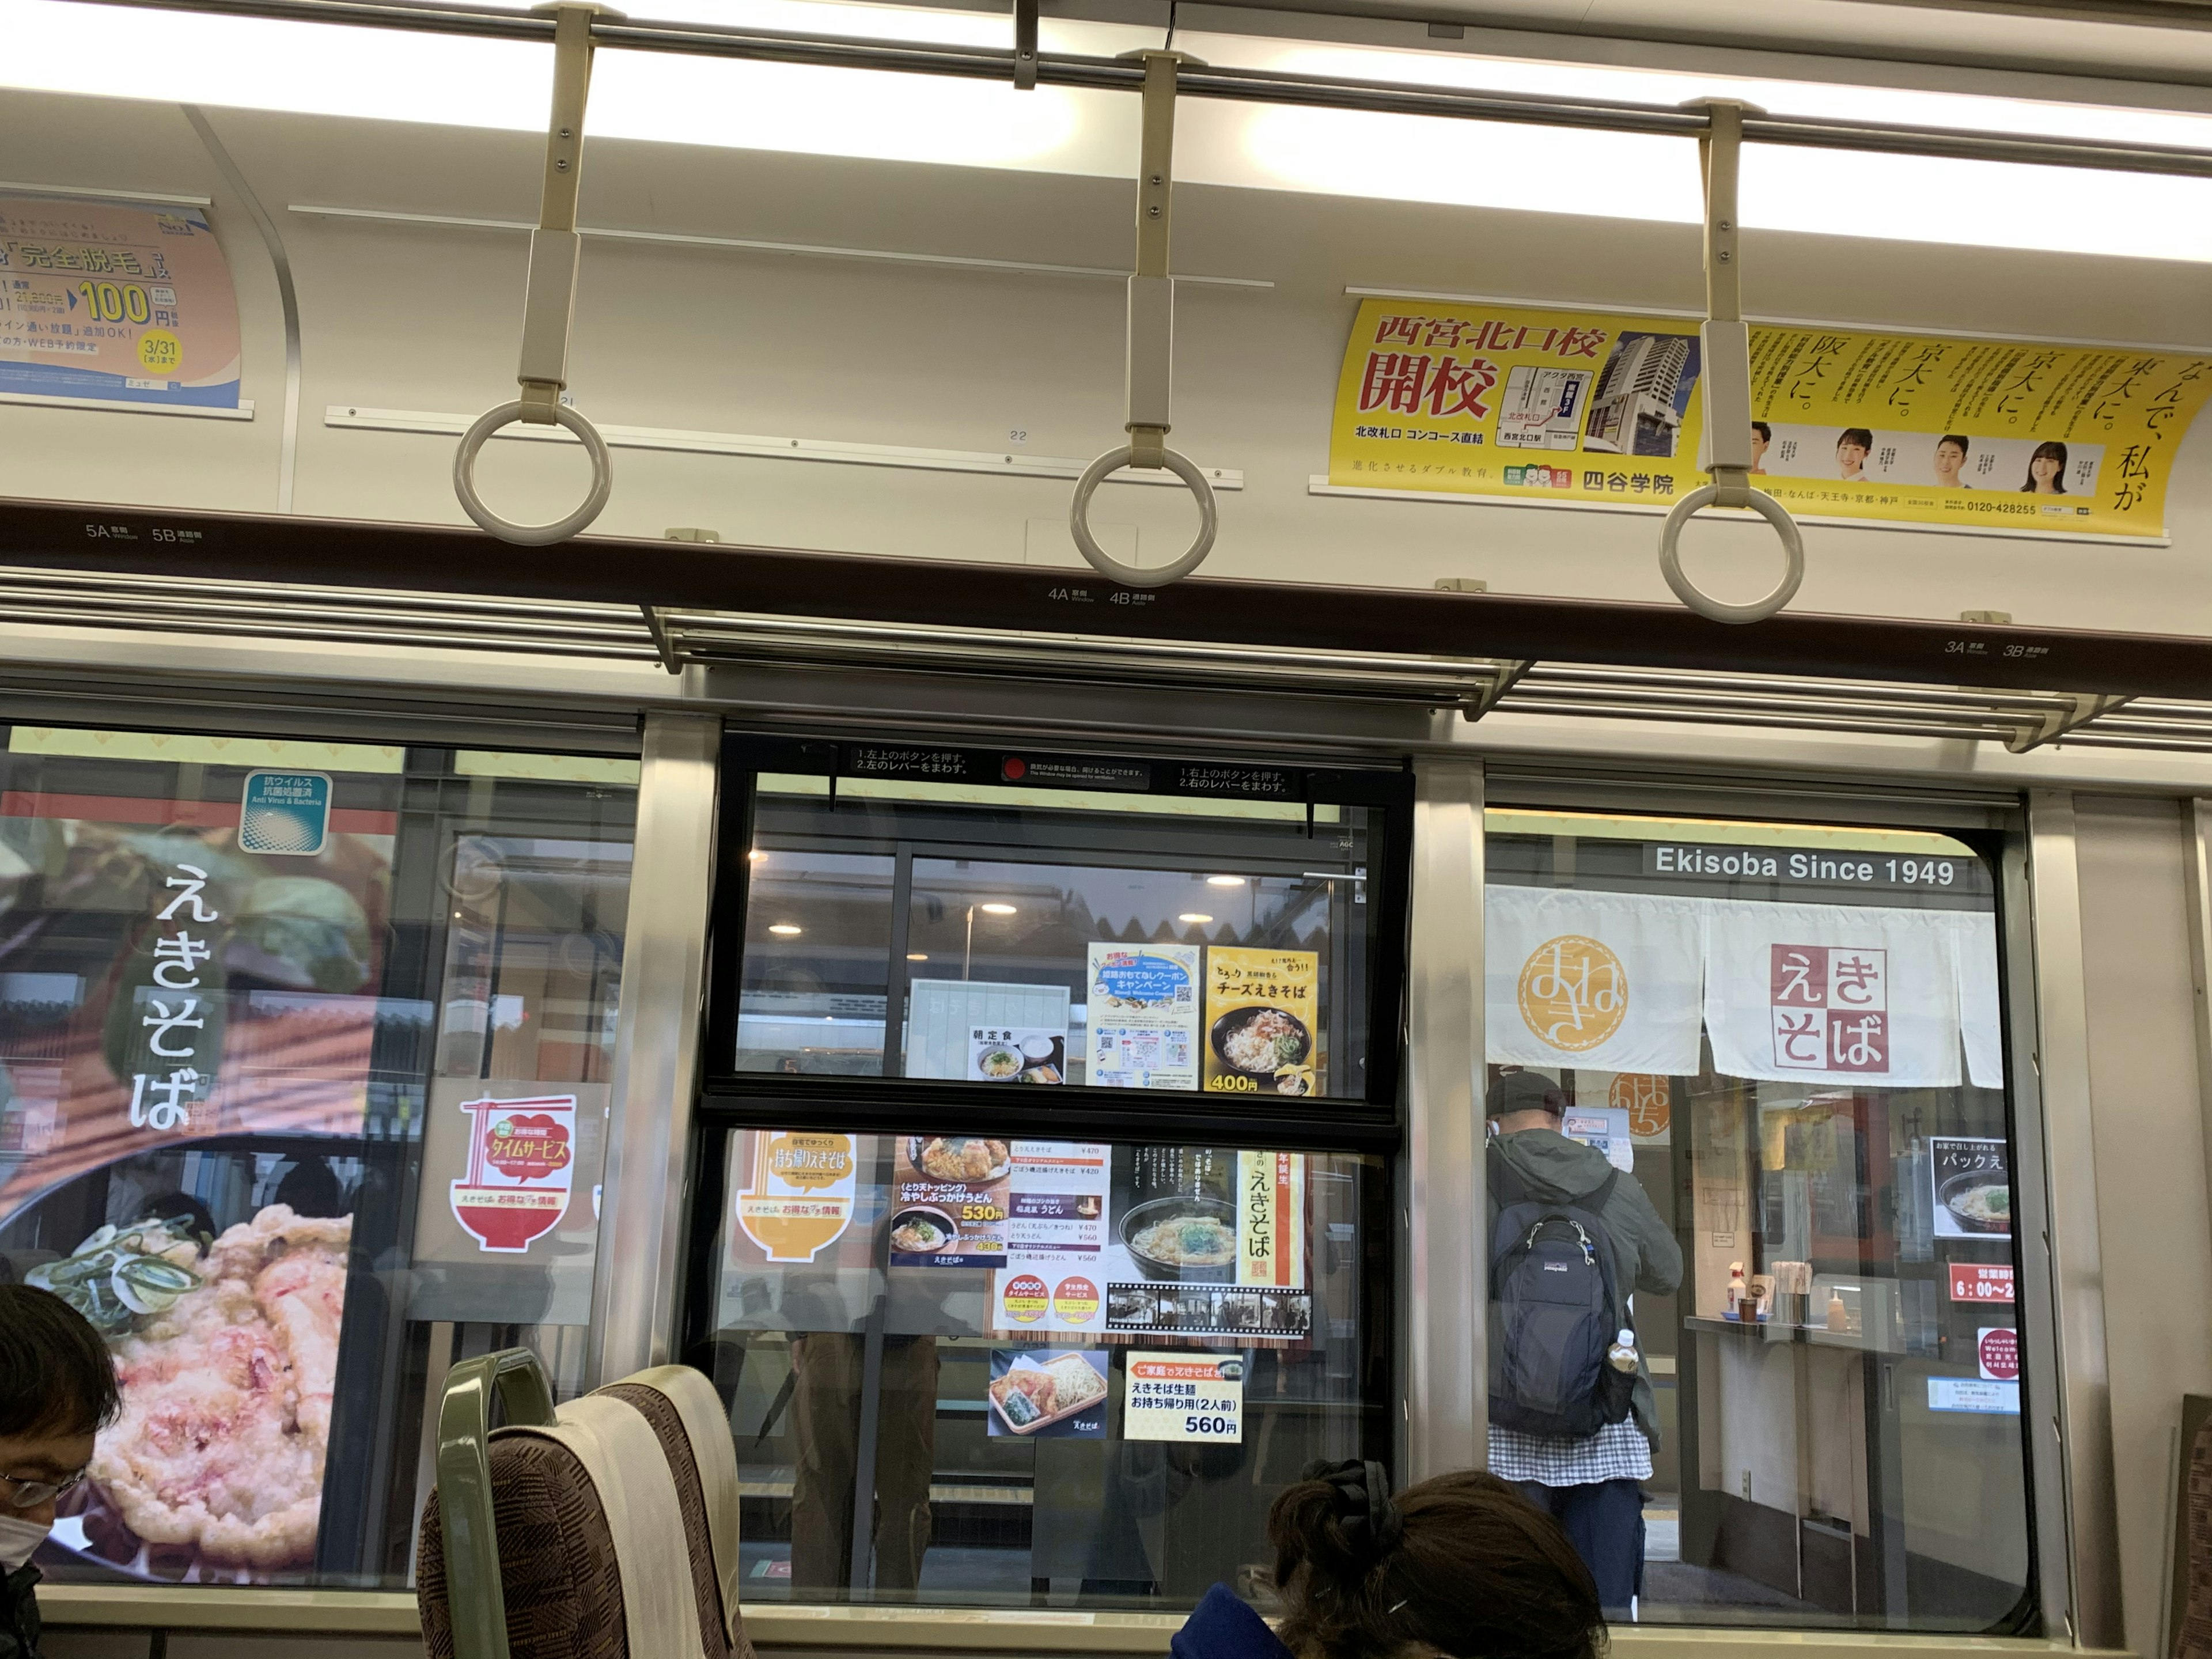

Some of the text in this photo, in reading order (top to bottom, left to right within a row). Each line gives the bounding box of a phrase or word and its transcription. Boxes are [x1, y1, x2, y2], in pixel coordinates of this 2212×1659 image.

[79, 281, 150, 325] 100
[156, 310, 170, 327] 円
[0, 320, 132, 340] イン通い放題」追加OK!
[1375, 316, 1608, 358] 西宮北口校
[145, 340, 175, 355] 3/31
[1543, 372, 1584, 380] アクタ西宮
[1790, 335, 1851, 410] 阪大に。
[128, 380, 149, 389] ミュゼ
[1358, 352, 1499, 418] 開校
[1889, 344, 1952, 416] 京大に。
[1997, 351, 2066, 424] 京大に。
[2093, 358, 2165, 430] 東大に。
[1508, 412, 1540, 421] 北改札口
[1010, 430, 1027, 441] 22
[1356, 426, 1484, 445] 北改札口 コンコース直結
[1504, 433, 1541, 442] 西宮北口駅
[2113, 361, 2212, 512] なんで、私が
[1584, 471, 1674, 495] 四谷学院
[1968, 502, 2036, 515] 0120-428255
[86, 525, 110, 538] 5A
[152, 529, 176, 542] 5B
[1048, 588, 1069, 601] 4A
[1109, 592, 1130, 605] 4B
[1945, 641, 1965, 654] 3A
[2003, 645, 2025, 657] 3B
[858, 749, 965, 764] 1.左上のボタンを押す。
[857, 760, 967, 774] 2.左のレバーをまわす。
[1181, 768, 1285, 782] 1.右上のボタンを押す。
[264, 777, 313, 787] 抗ウイルス
[1180, 778, 1286, 793] 2.右のレバーをまわす。
[294, 798, 322, 806] Bacteria
[1656, 846, 1955, 885] Ekisoba Since 1949
[1106, 952, 1127, 960] お得な
[1286, 964, 1309, 972] 合う!!
[1102, 971, 1187, 981] 姫路おもてなしクーポン
[1116, 980, 1171, 990] キャンペーン
[1217, 982, 1306, 999] チーズえきそば
[129, 863, 218, 1130] えきそば
[973, 1030, 1012, 1040] 朝定食
[1211, 1074, 1258, 1092] 400円
[792, 1138, 834, 1146] 自宅でゆっくり
[1936, 1142, 1996, 1151] お家で召し上がれる
[491, 1139, 567, 1160] タイムサービス
[774, 1149, 847, 1169] 持ち帰りえきそば
[1943, 1153, 2003, 1170] パックえ
[900, 1192, 993, 1204] 冷やしぶっかけうどん
[961, 1205, 1003, 1220] 530円
[1041, 1205, 1063, 1214] うどん
[1249, 1171, 1270, 1258] えきそば
[946, 1233, 1003, 1242] 冷やしぶっかけうどん
[976, 1242, 1003, 1252] 430円
[934, 1256, 960, 1264] えきそば
[1131, 1383, 1196, 1396] えきそば生麺
[1131, 1397, 1237, 1412] お持ち帰り用(2人前)
[1073, 1421, 1097, 1430] えきそば
[1185, 1416, 1237, 1435] 560円
